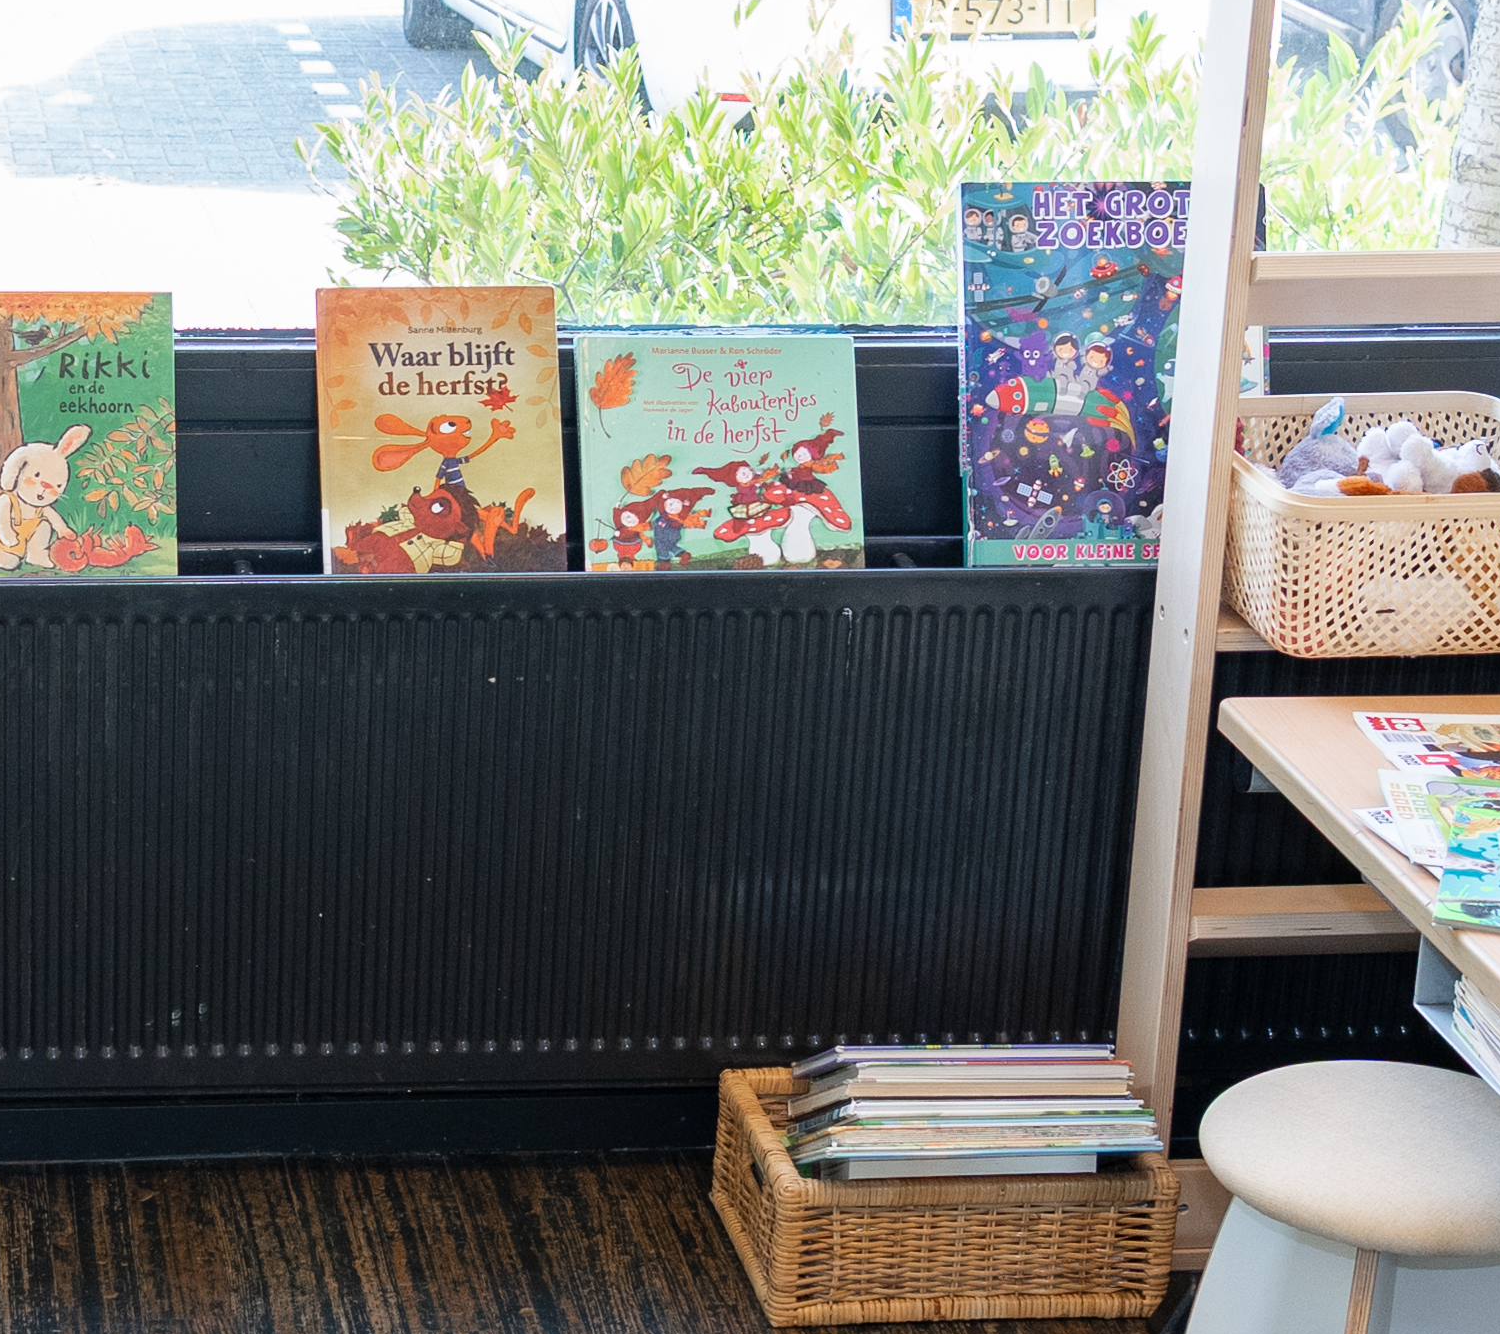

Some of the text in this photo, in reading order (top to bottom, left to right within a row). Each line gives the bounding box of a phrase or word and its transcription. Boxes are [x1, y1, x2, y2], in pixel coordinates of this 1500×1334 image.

[1033, 190, 1091, 219] HET
[58, 351, 151, 379] Rikki
[368, 341, 515, 373] Waar blijft
[69, 381, 105, 394] en de
[378, 371, 410, 396] de
[672, 361, 773, 391] De vier
[59, 397, 134, 414] eekhoorn
[667, 417, 787, 454] in de herfst
[1012, 544, 1068, 561] VOOR
